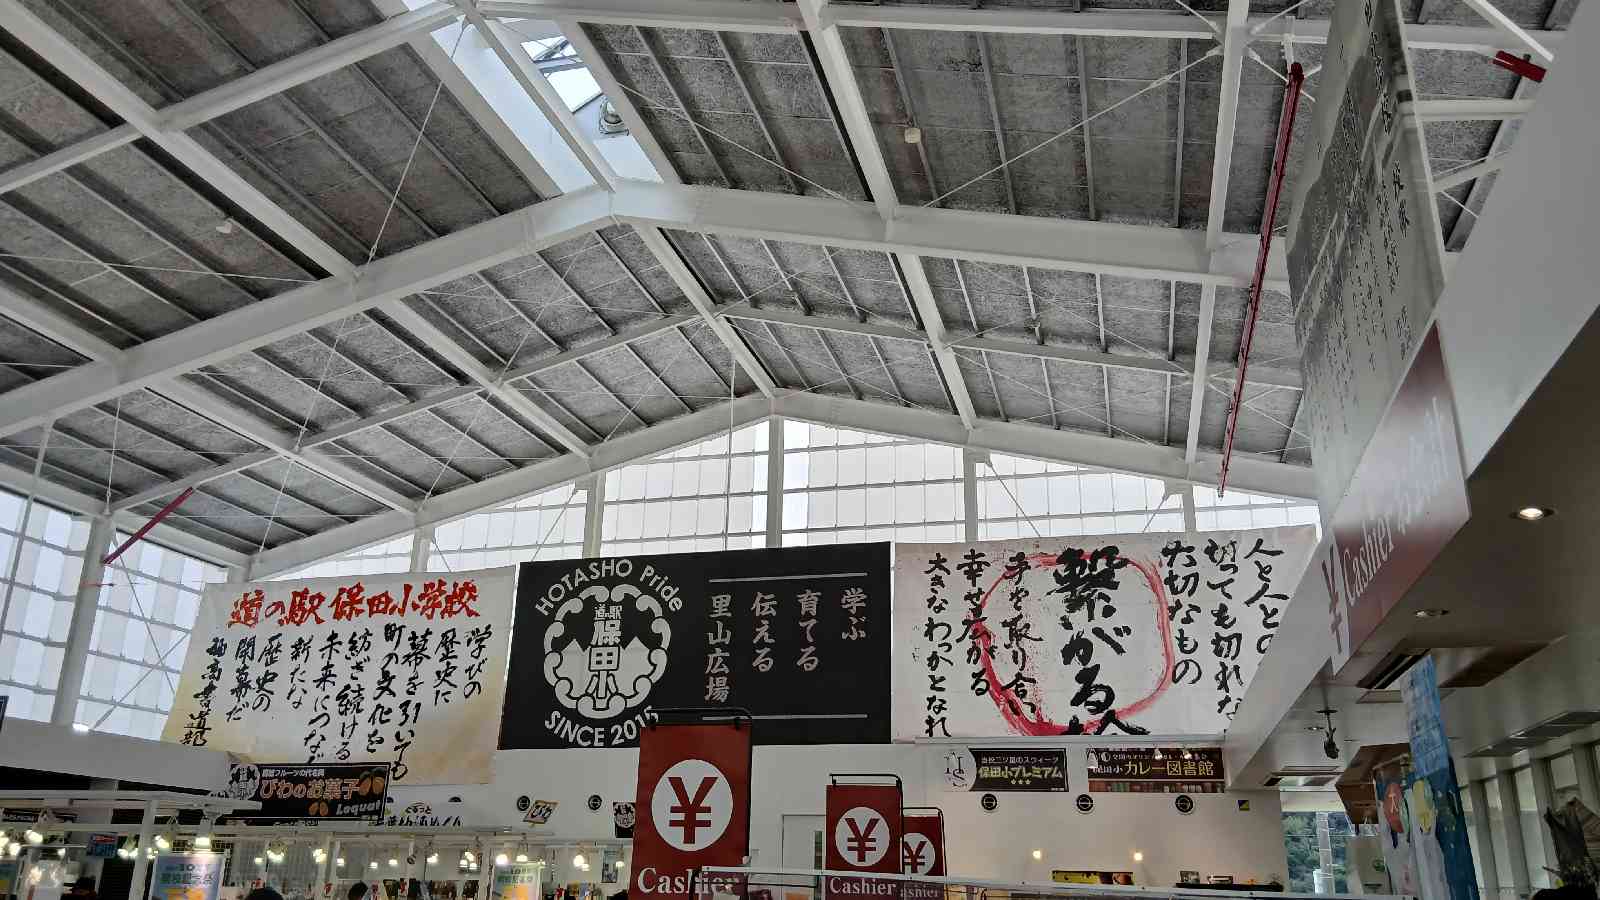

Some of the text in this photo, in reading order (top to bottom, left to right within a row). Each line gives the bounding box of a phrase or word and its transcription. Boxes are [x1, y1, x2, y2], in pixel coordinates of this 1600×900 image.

[535, 559, 683, 616] HOTASHO Pride
[1343, 512, 1394, 607] Cashier
[751, 592, 777, 671] 伝える
[797, 589, 822, 671] 育てる
[841, 588, 868, 640] 学ぶ
[704, 594, 732, 702] 里山広場
[545, 710, 604, 746] SINCE
[259, 778, 360, 800] びわのお菓子
[829, 877, 897, 895] Cashier
